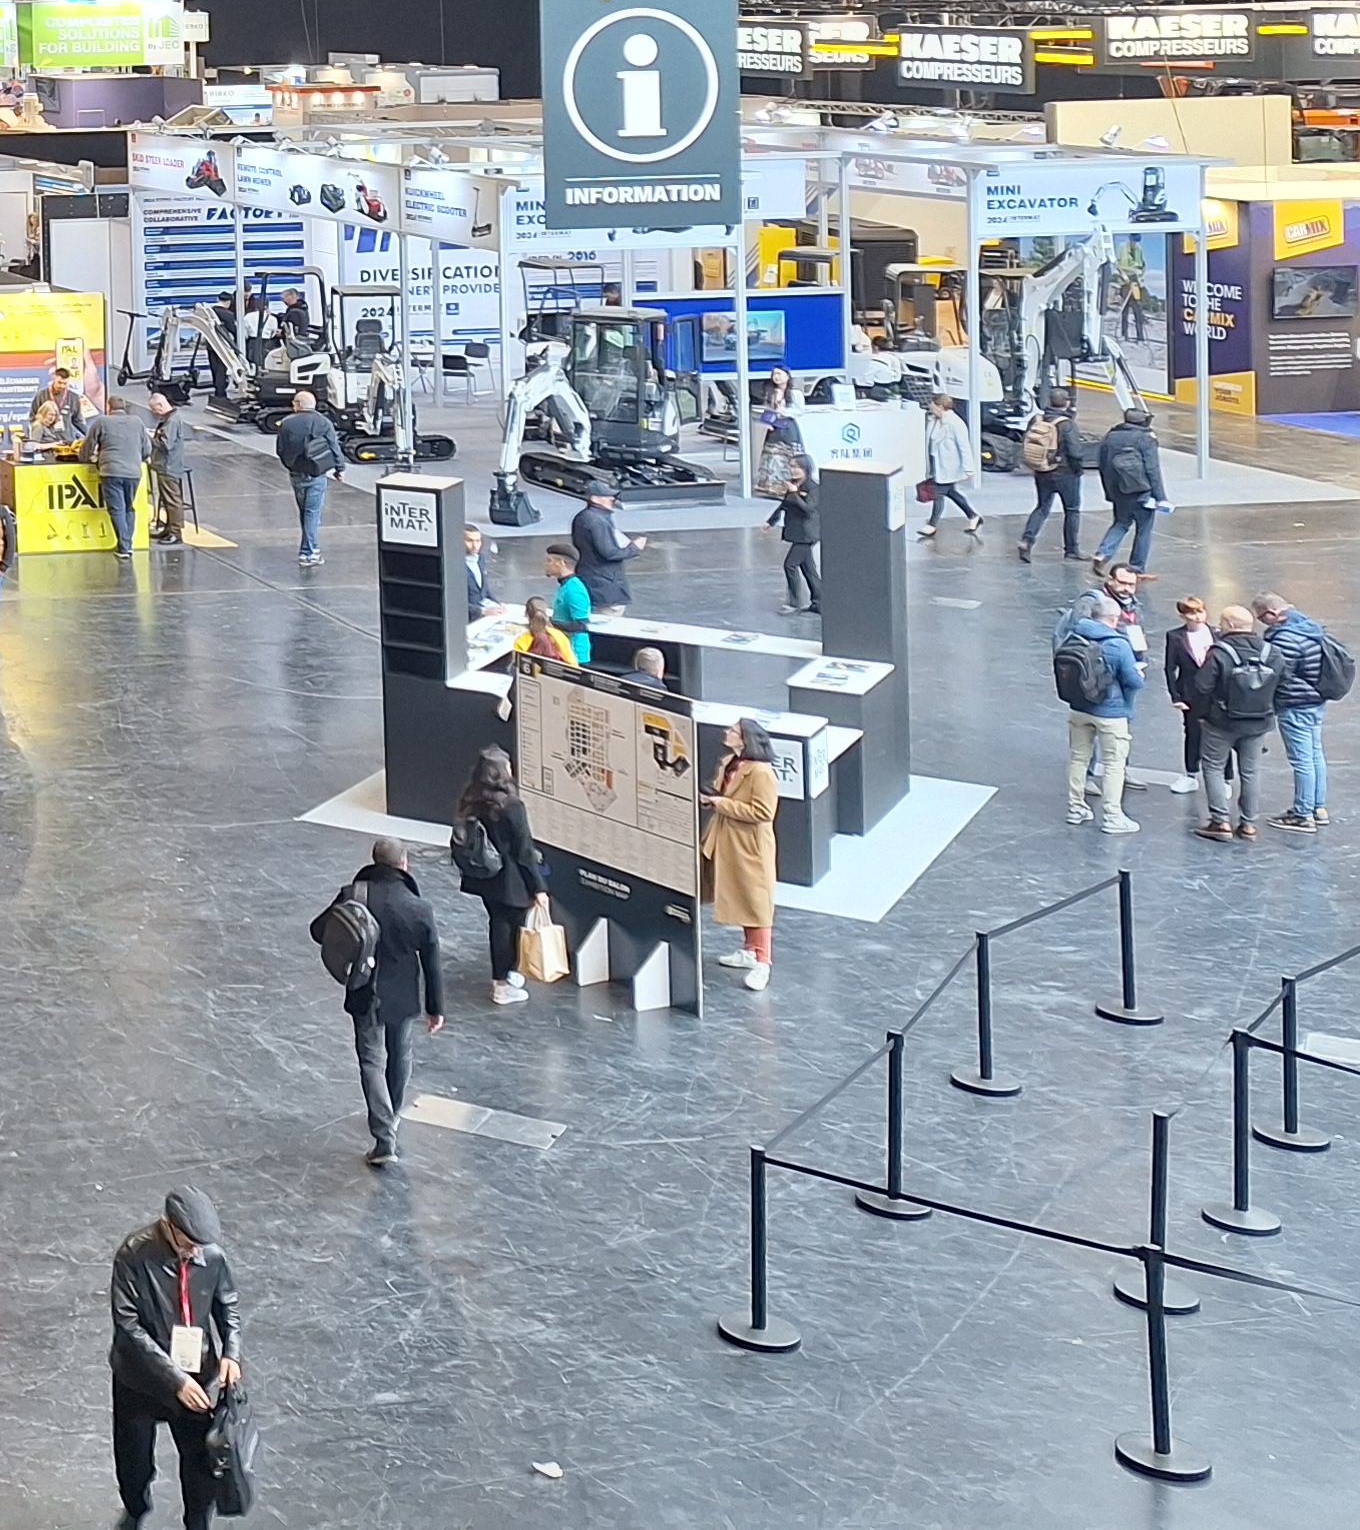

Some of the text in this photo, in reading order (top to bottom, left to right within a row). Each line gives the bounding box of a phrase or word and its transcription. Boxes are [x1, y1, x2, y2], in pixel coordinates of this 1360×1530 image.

[1108, 14, 1250, 40] KAESER
[57, 28, 141, 41] SOLUTIONS
[737, 27, 803, 54] ESER
[38, 40, 142, 54] FOR BUILDING
[159, 40, 181, 50] JEC
[900, 32, 1024, 65] KAESER
[1109, 37, 1250, 58] COMPRESSEURS
[737, 52, 803, 73] RESSEURS
[901, 60, 1024, 86] COMPRESSEURS
[564, 183, 722, 206] INFORMATION
[986, 184, 1022, 197] MINI
[436, 204, 468, 218] SCOOTER
[516, 200, 546, 212] MIN
[986, 197, 1079, 211] EXCAVATOR
[143, 215, 199, 223] COLLABORATIVE
[1286, 218, 1328, 239] CARMIX
[443, 282, 500, 295] PROVIDE
[1206, 298, 1222, 312] HE
[389, 516, 429, 533] MAT.
[522, 662, 532, 674] 6
